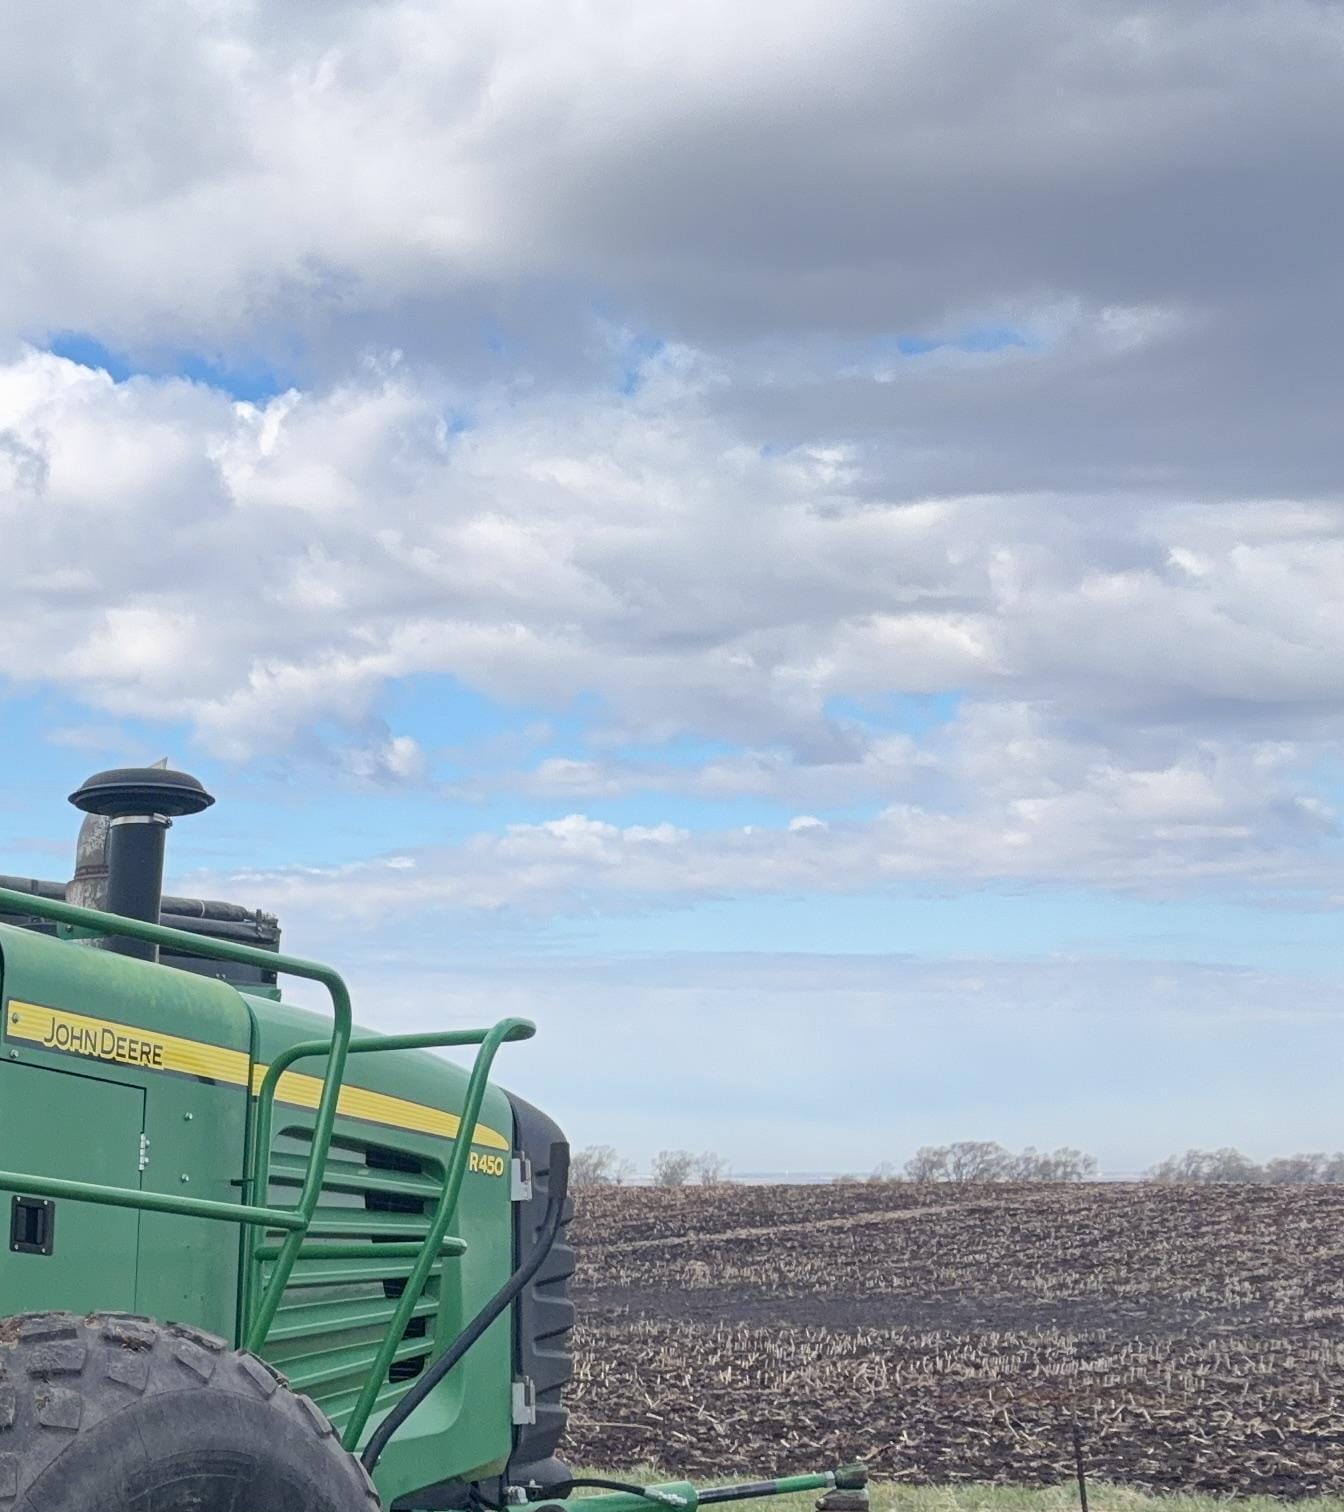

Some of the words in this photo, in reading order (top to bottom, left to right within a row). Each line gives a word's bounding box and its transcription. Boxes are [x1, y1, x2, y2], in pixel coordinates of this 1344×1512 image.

[44, 1016, 97, 1052] JOHN
[100, 1027, 164, 1066] DEERE
[469, 1151, 504, 1177] R450
